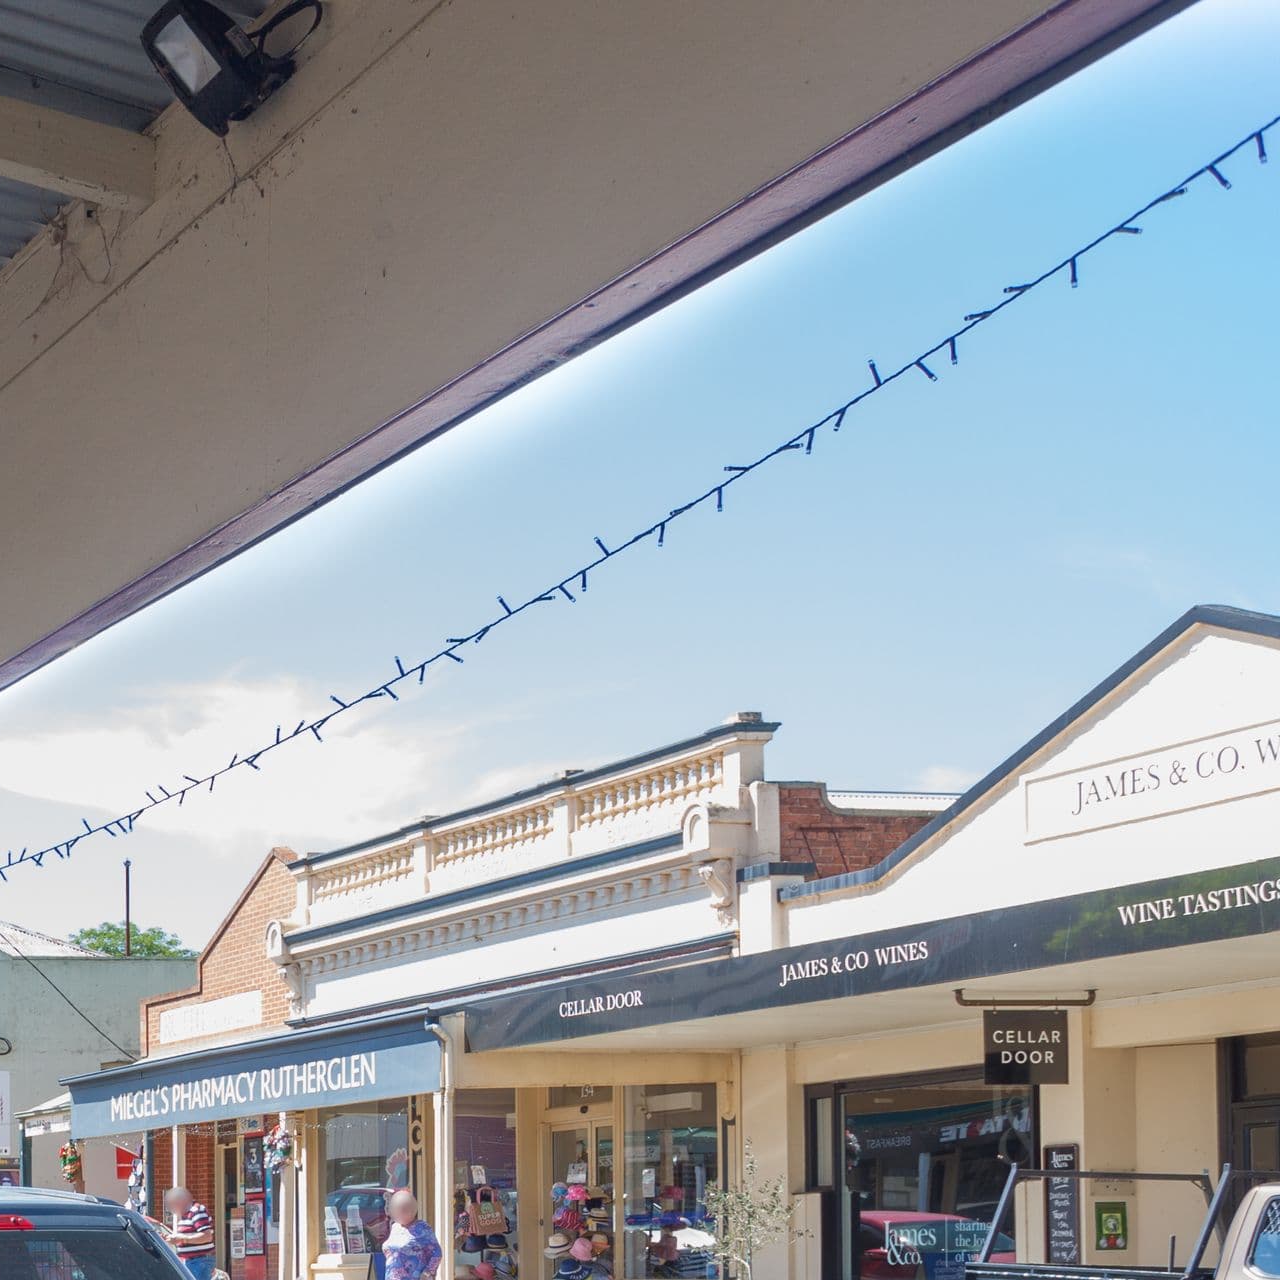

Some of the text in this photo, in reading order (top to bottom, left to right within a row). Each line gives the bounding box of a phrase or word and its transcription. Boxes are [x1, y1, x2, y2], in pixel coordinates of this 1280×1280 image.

[1071, 763, 1161, 816] JAMES
[1168, 760, 1188, 786] &
[1196, 746, 1246, 779] CO.
[1117, 898, 1176, 927] WINE
[779, 941, 929, 987] JAMES & CO WINES
[558, 990, 643, 1018] CELLAR DOOR
[992, 1030, 1061, 1044] CELLAR
[1001, 1050, 1055, 1064] DOOR
[111, 1051, 376, 1122] MIEGEL'S PHARMACY RUTHERGLEN
[478, 1211, 501, 1220] SUPER
[880, 1219, 937, 1253] James
[955, 1233, 972, 1248] the
[954, 1250, 965, 1263] of
